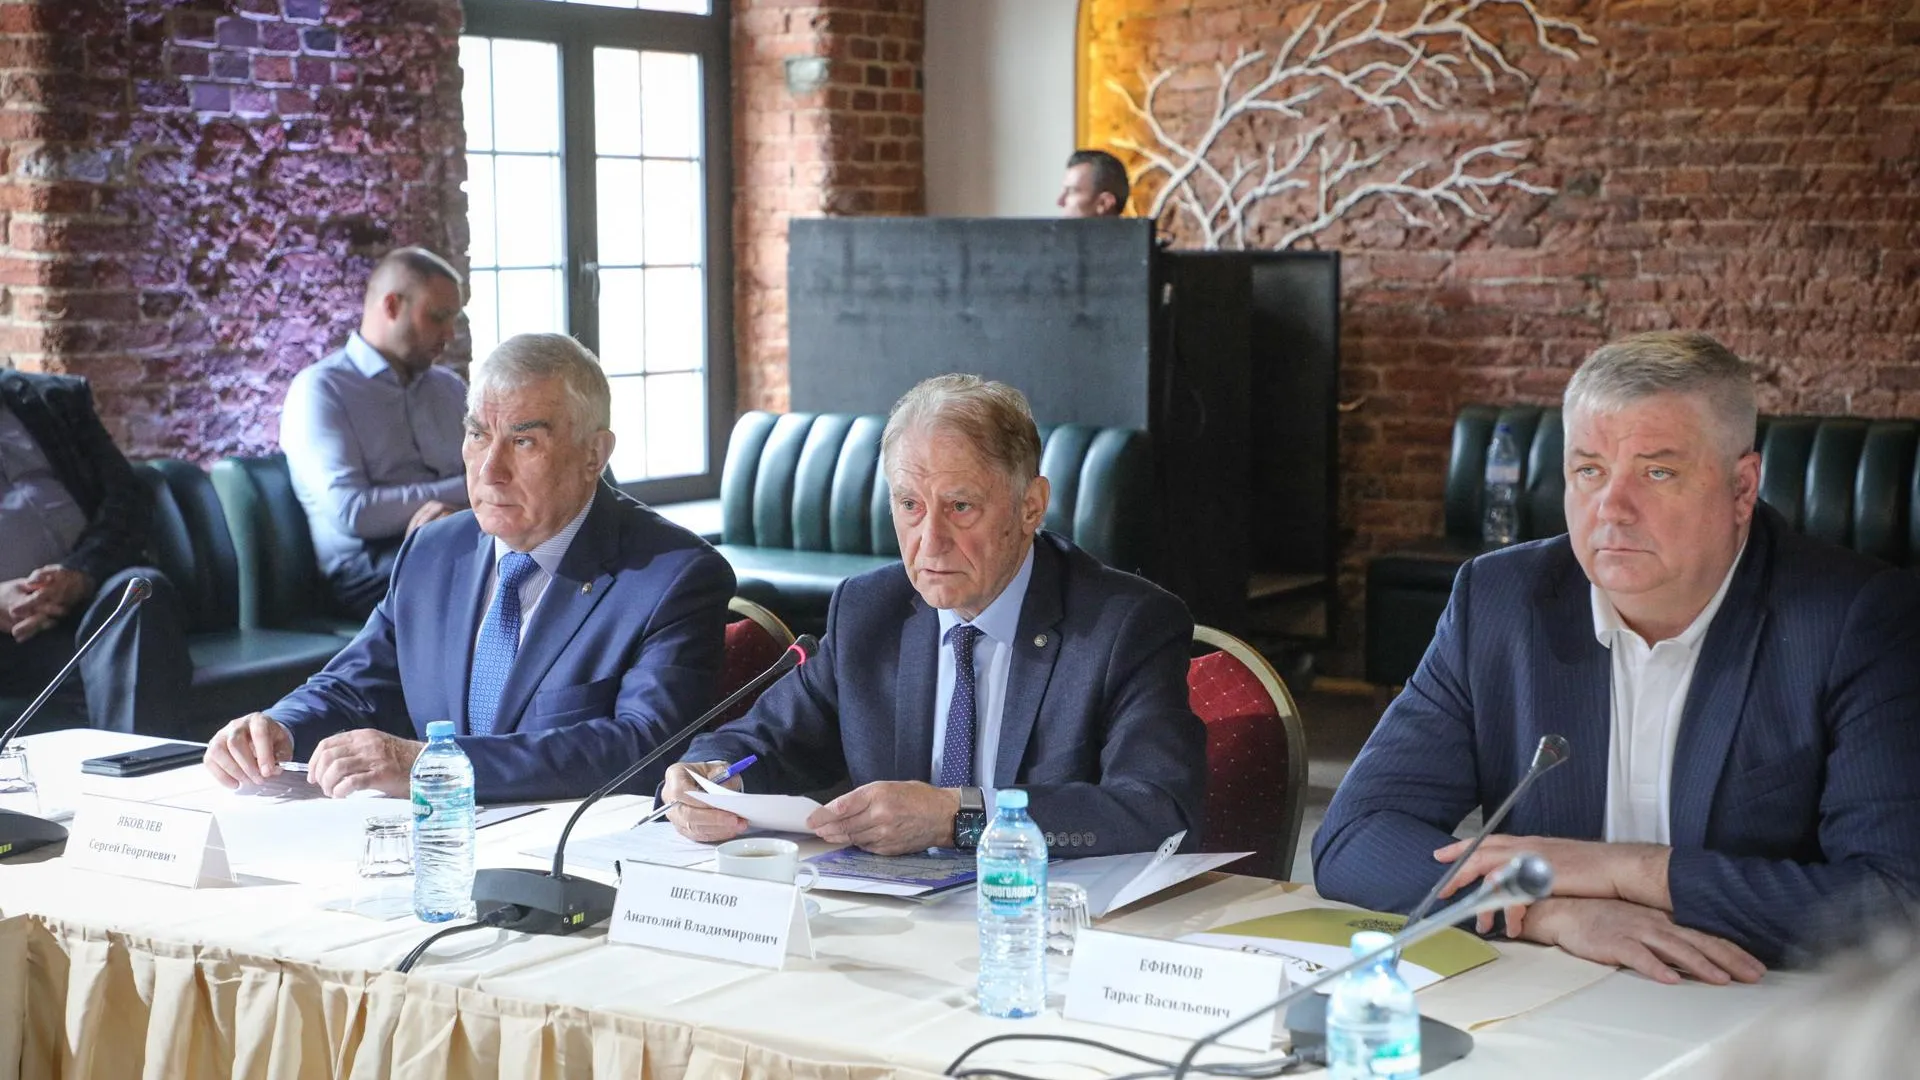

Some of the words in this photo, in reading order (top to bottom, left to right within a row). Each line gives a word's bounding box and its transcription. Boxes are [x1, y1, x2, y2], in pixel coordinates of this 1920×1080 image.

[117, 814, 163, 832] ЯКОВЛЕВ
[89, 838, 120, 853] Сергей
[670, 886, 738, 908] ШЕСТАКОВ
[623, 909, 681, 929] Анатолий
[684, 918, 778, 946] Владимирович
[1140, 958, 1204, 980] ЕФИМОВ
[1103, 986, 1142, 1005] Тарас
[1144, 992, 1231, 1018] Васильевич
